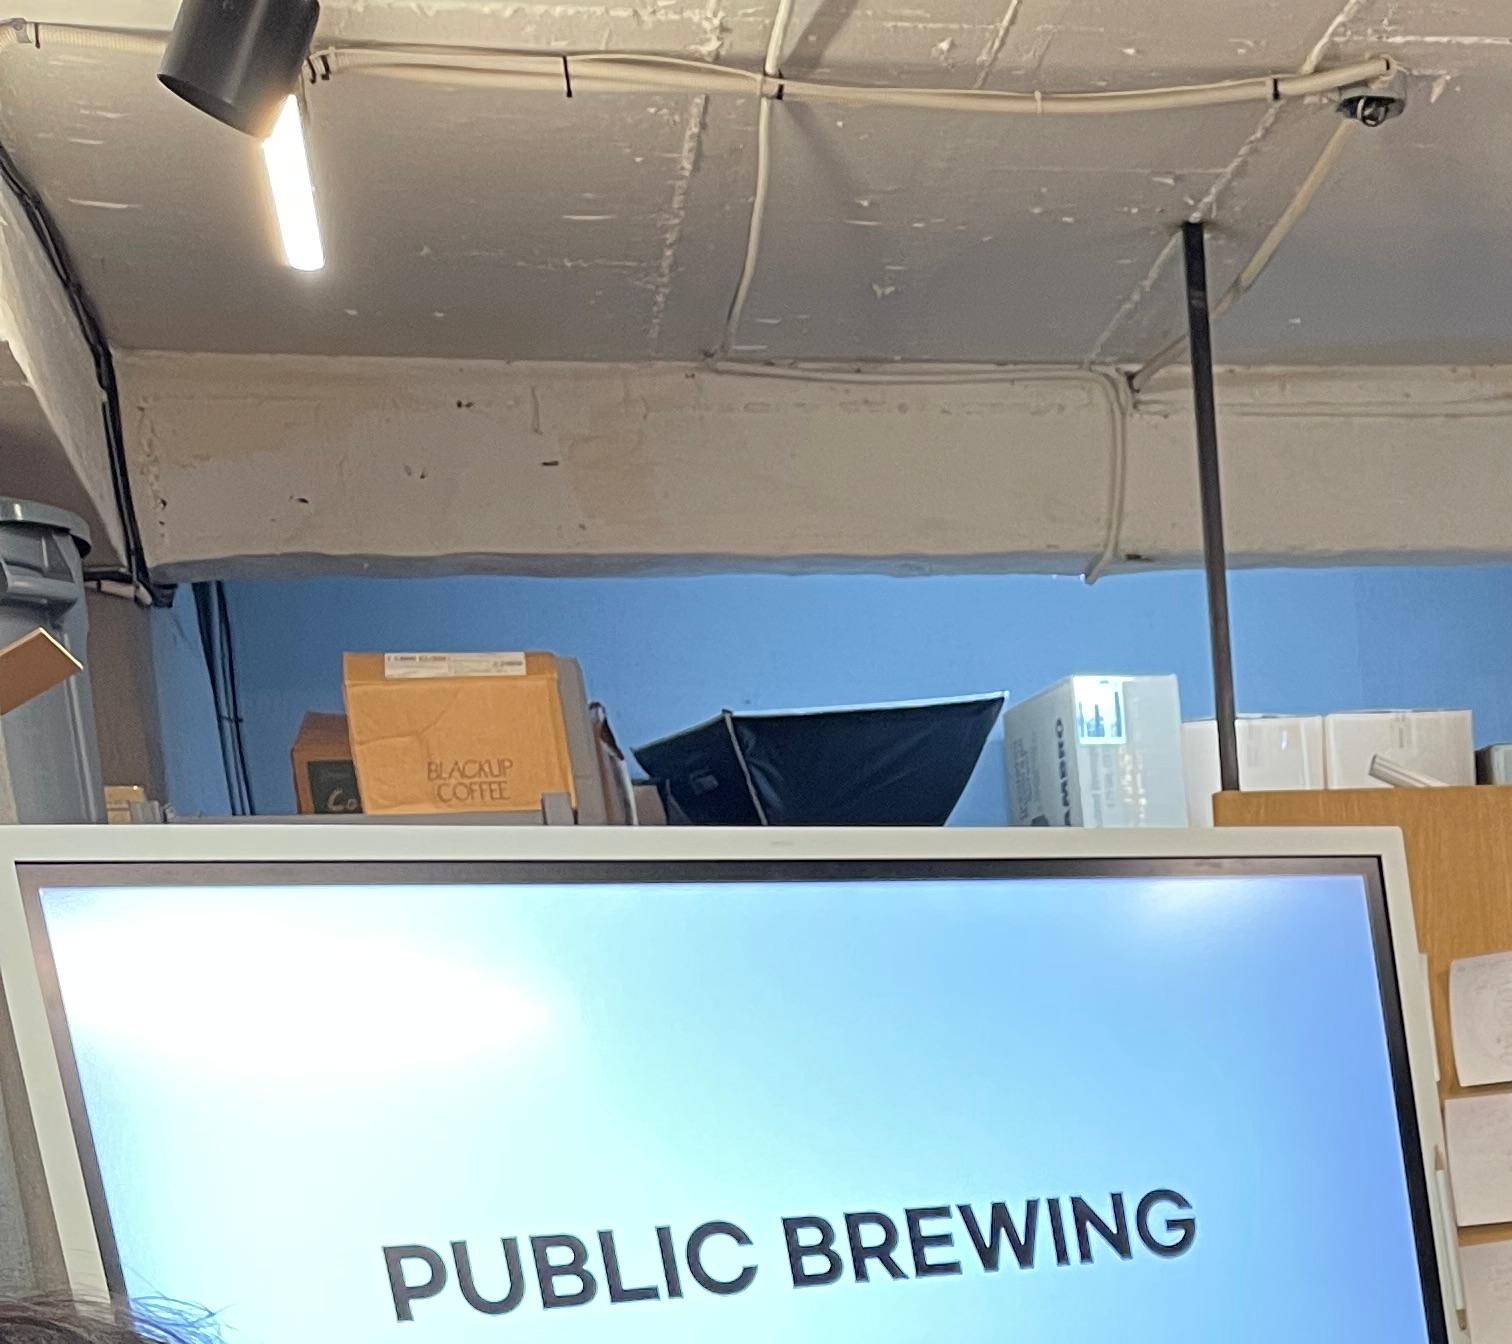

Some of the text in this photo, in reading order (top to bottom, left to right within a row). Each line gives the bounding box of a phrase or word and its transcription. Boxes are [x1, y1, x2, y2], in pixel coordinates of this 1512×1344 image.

[426, 757, 514, 782] BLACKUP
[436, 780, 511, 803] COFFEE
[383, 1187, 1197, 1322] PUBLIC BREWING
